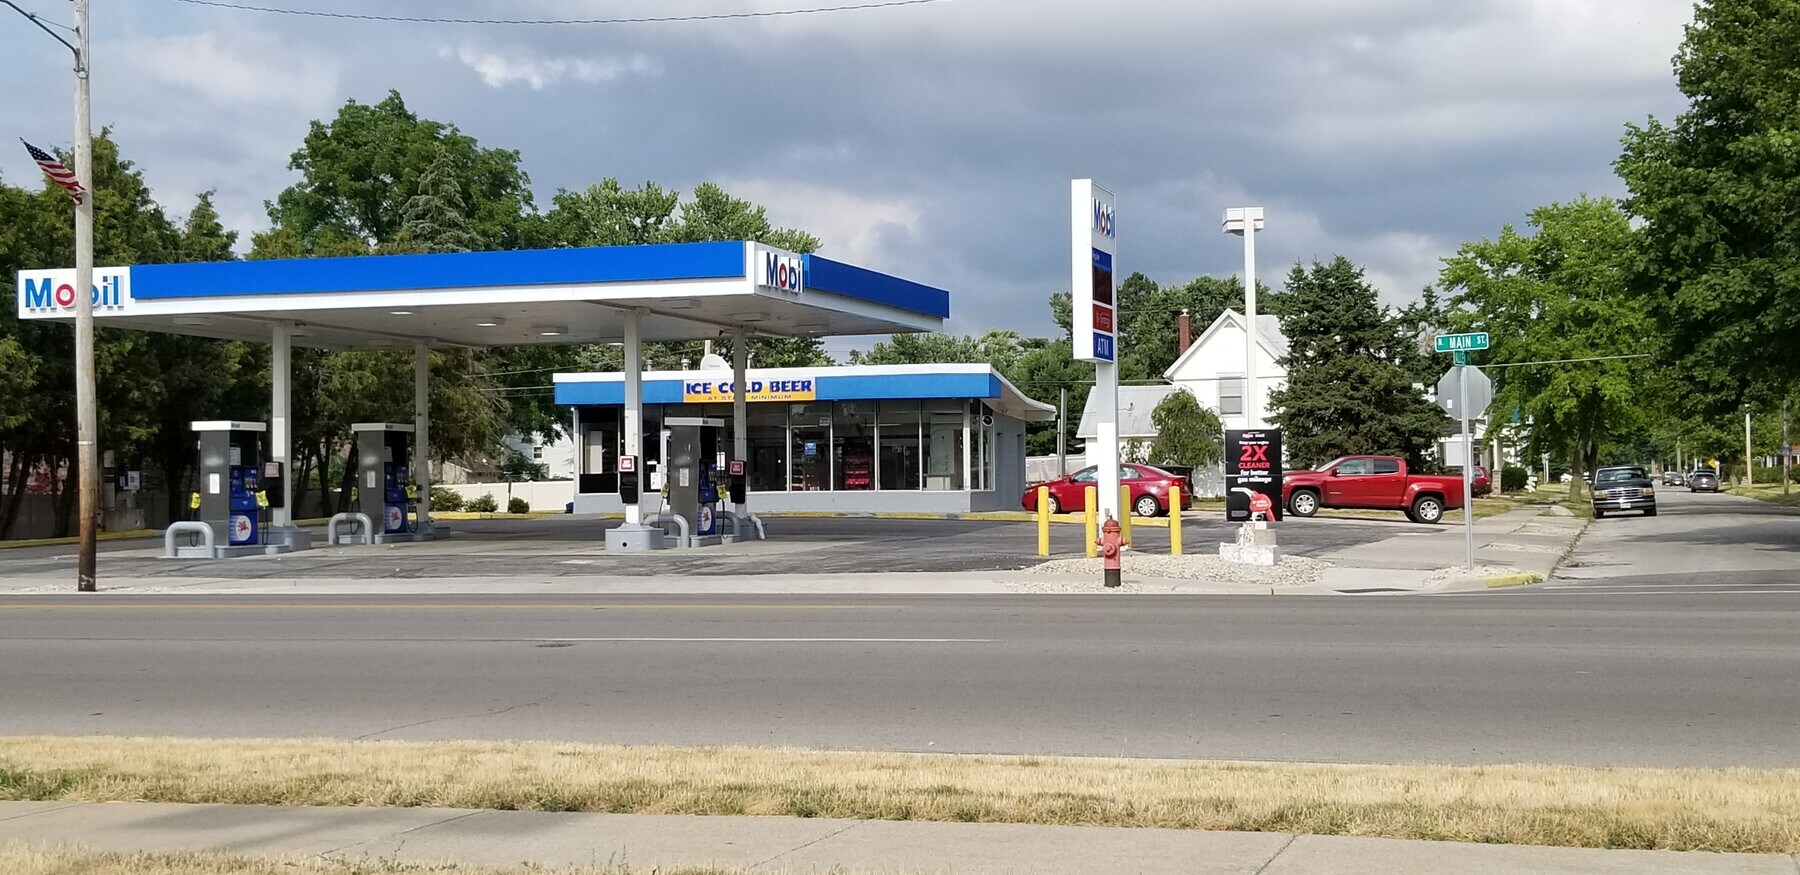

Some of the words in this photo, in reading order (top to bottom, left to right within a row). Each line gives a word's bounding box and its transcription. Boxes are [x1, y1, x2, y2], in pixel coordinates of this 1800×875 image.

[766, 251, 805, 293] Mobil
[1096, 337, 1110, 356] ATM
[1449, 336, 1471, 348] MAIN
[686, 382, 711, 394] ICE
[769, 380, 811, 393] BEER
[1240, 445, 1267, 461] 2X
